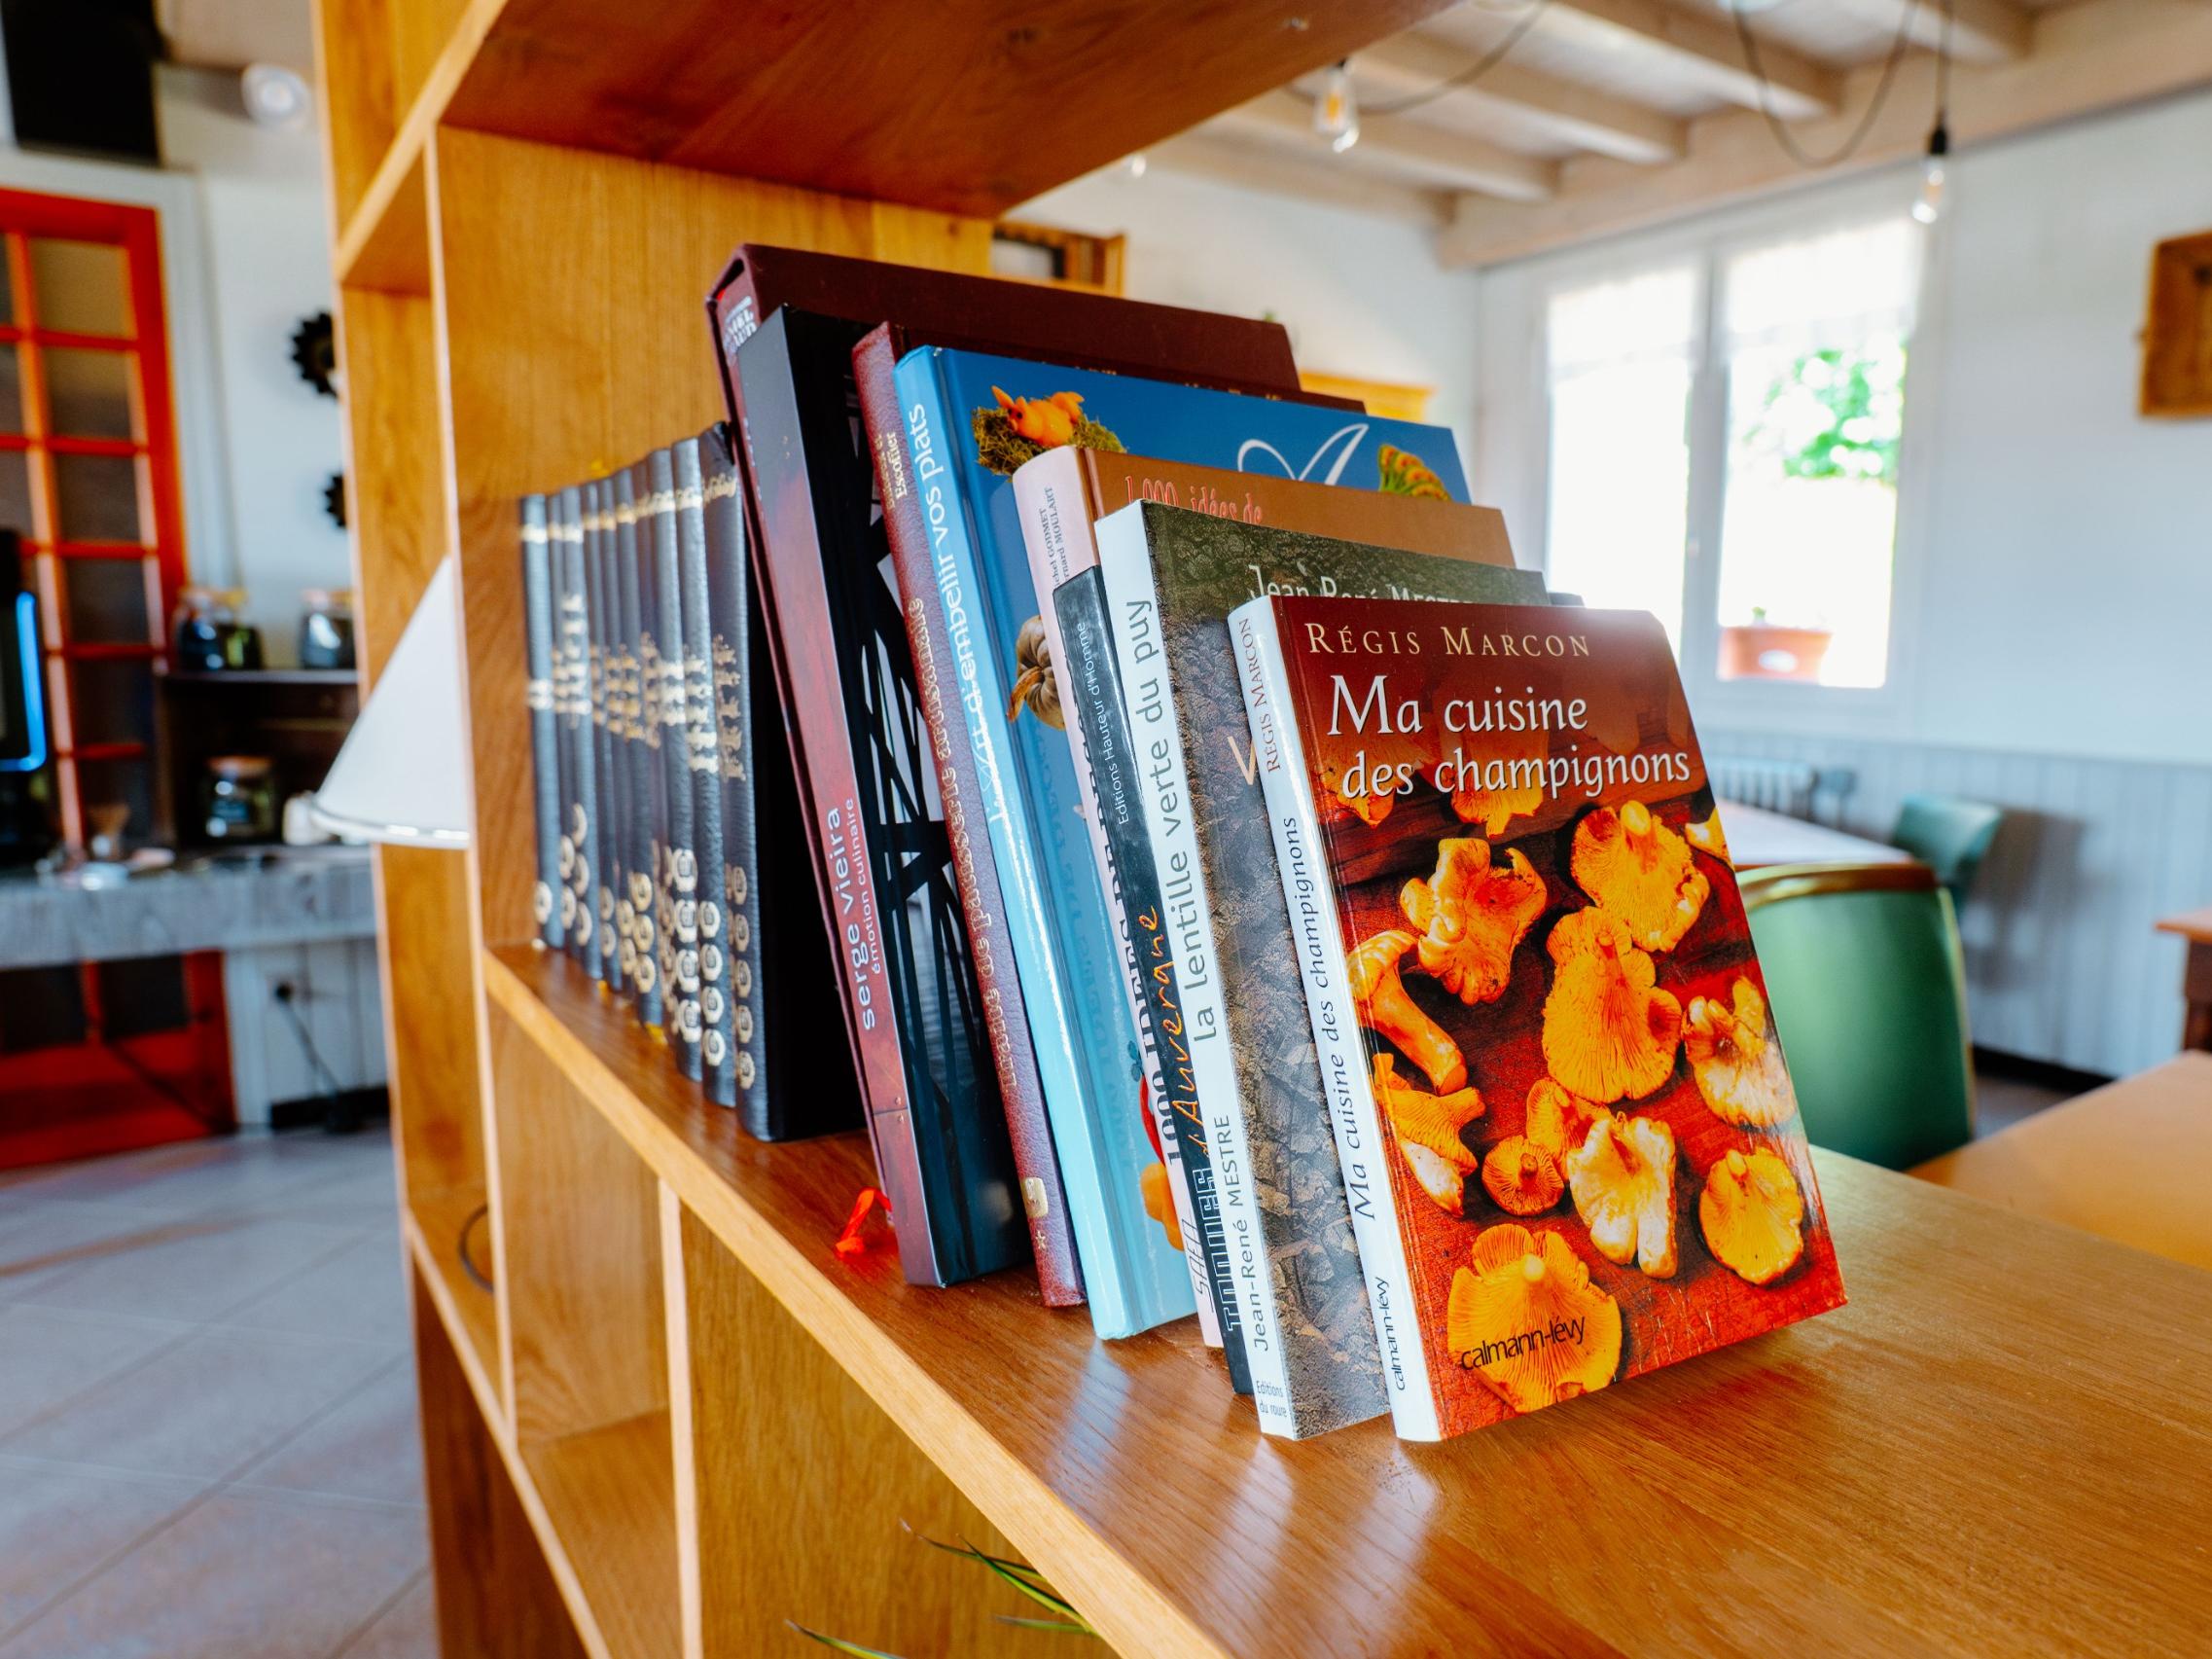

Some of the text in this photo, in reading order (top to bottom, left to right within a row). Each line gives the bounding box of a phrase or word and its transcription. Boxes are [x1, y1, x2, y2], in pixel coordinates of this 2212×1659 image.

[886, 432, 909, 499] Escoffier
[909, 404, 945, 482] plats
[926, 486, 948, 550] vos
[1191, 486, 1237, 521] idées
[1243, 492, 1263, 525] de
[1049, 560, 1061, 588] ichel
[937, 553, 983, 713] d'embellir
[1238, 618, 1267, 708] MARCON
[1304, 622, 1591, 660] RÉGIS MARCON
[908, 596, 952, 762] artisanale
[1328, 674, 1588, 737] Ma cuisine
[1093, 700, 1115, 761] Hauteur
[1110, 762, 1129, 826] Editions
[1342, 746, 1691, 801] des champignons
[1126, 599, 1218, 1042] la lentille verte du puy
[827, 807, 875, 1031] serge vieira
[846, 798, 881, 974] émotion culinaire
[1283, 817, 1375, 1221] Ma cuisine des champignons
[1214, 1115, 1268, 1352] Jean-René MESTRE
[1375, 1277, 1406, 1391] calmann-lévy
[1461, 1316, 1586, 1371] calmann-lévy
